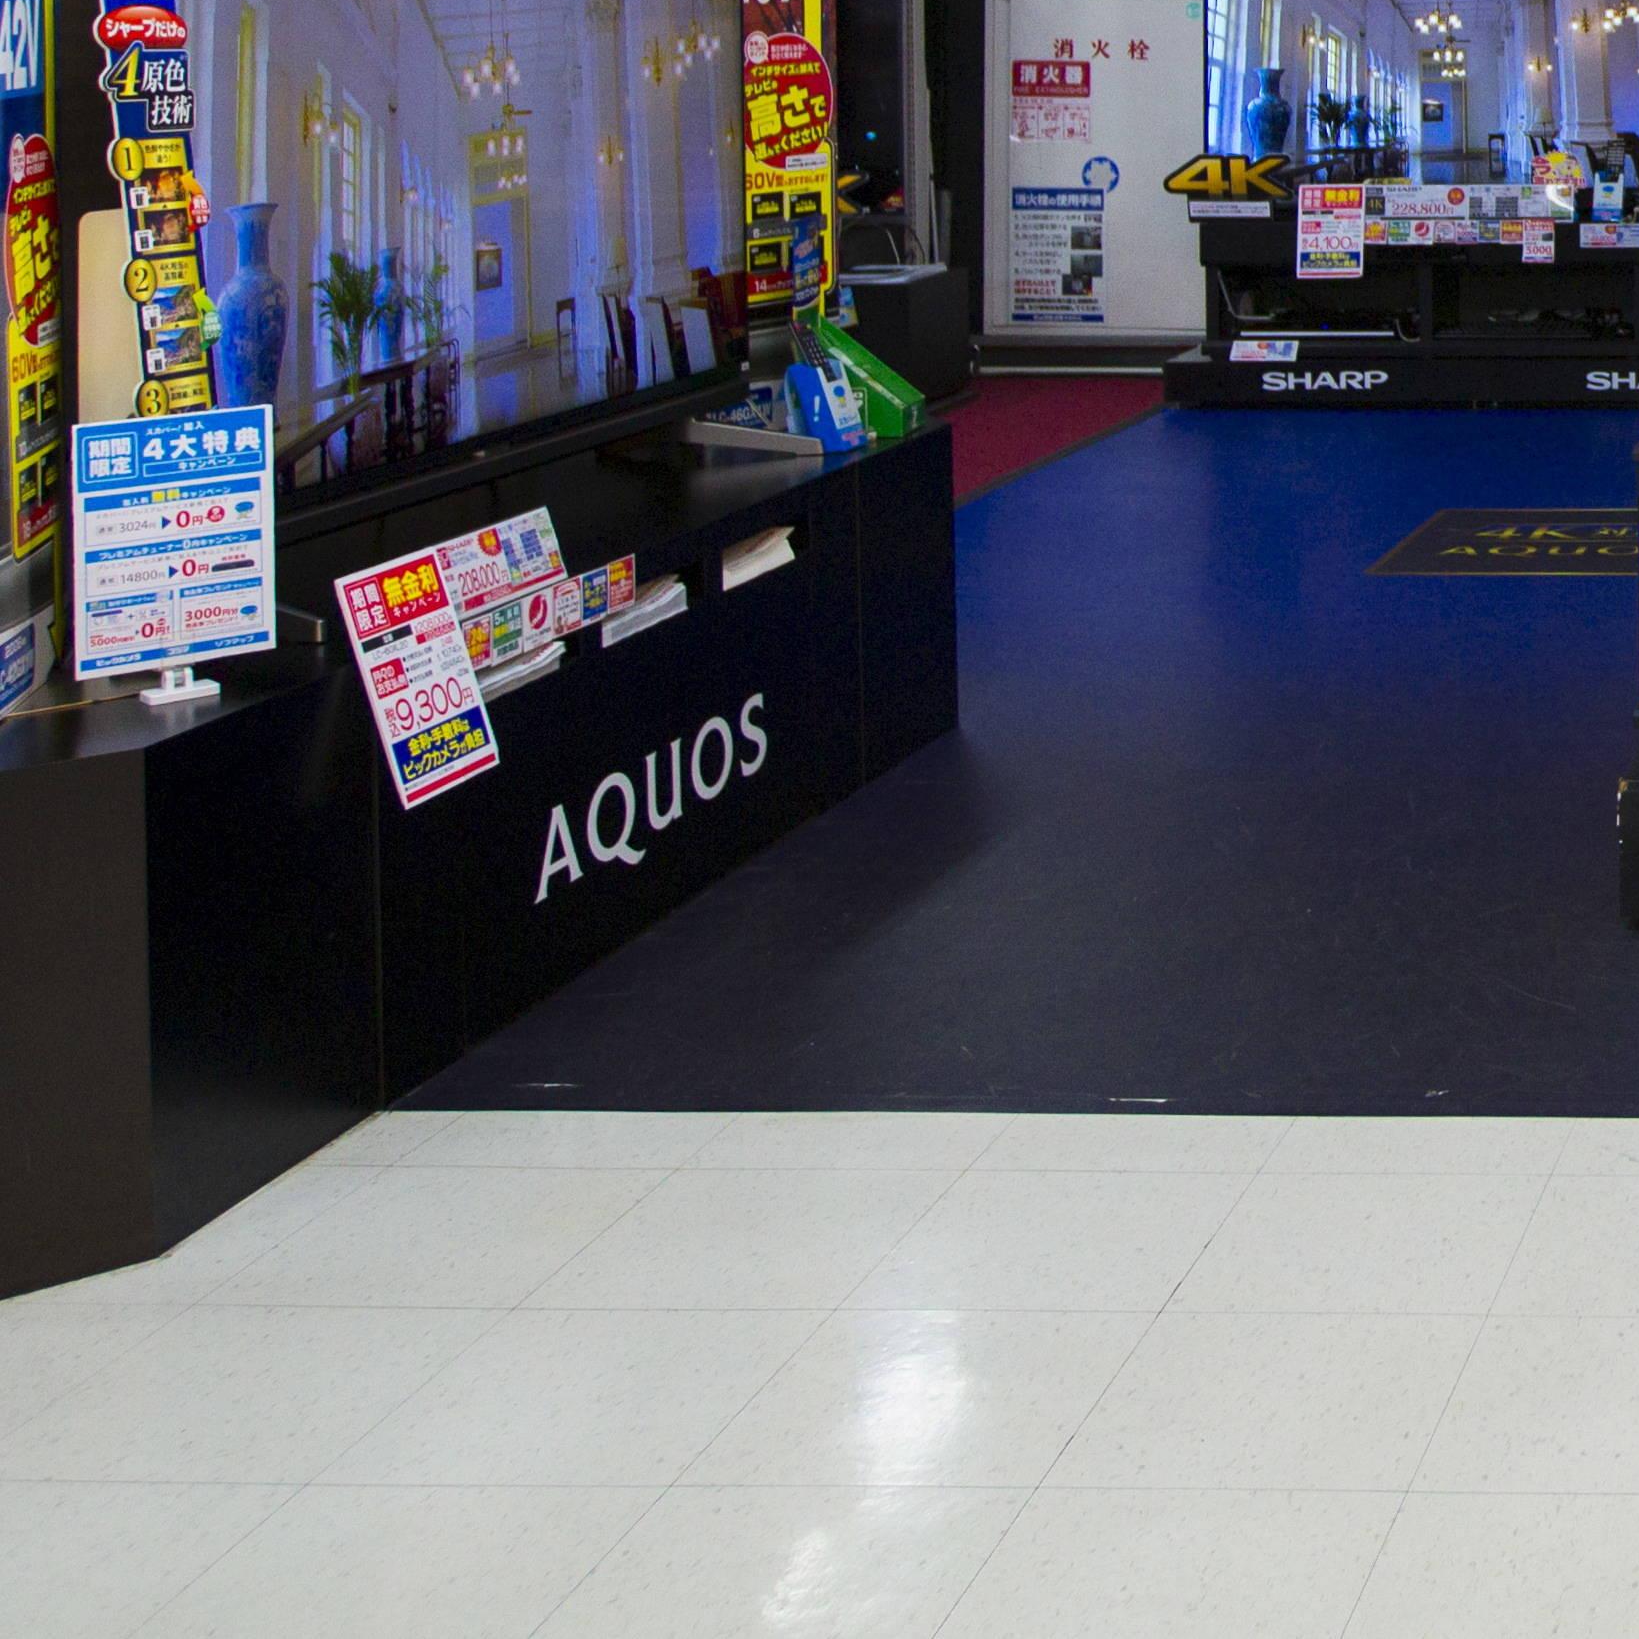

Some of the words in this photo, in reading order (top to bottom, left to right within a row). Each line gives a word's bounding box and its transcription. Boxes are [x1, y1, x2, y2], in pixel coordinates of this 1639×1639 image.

[1054, 39, 1150, 60] 消火栓
[1020, 64, 1083, 84] 消火器
[151, 93, 193, 125] 技術
[1167, 156, 1290, 195] 4K
[1262, 371, 1389, 391] SHARP
[142, 426, 261, 461] 4大特典
[178, 455, 236, 471] キャンペーン
[1438, 545, 1638, 557] AQUO
[382, 562, 439, 607] 無金利
[534, 692, 768, 904] AQUOS
